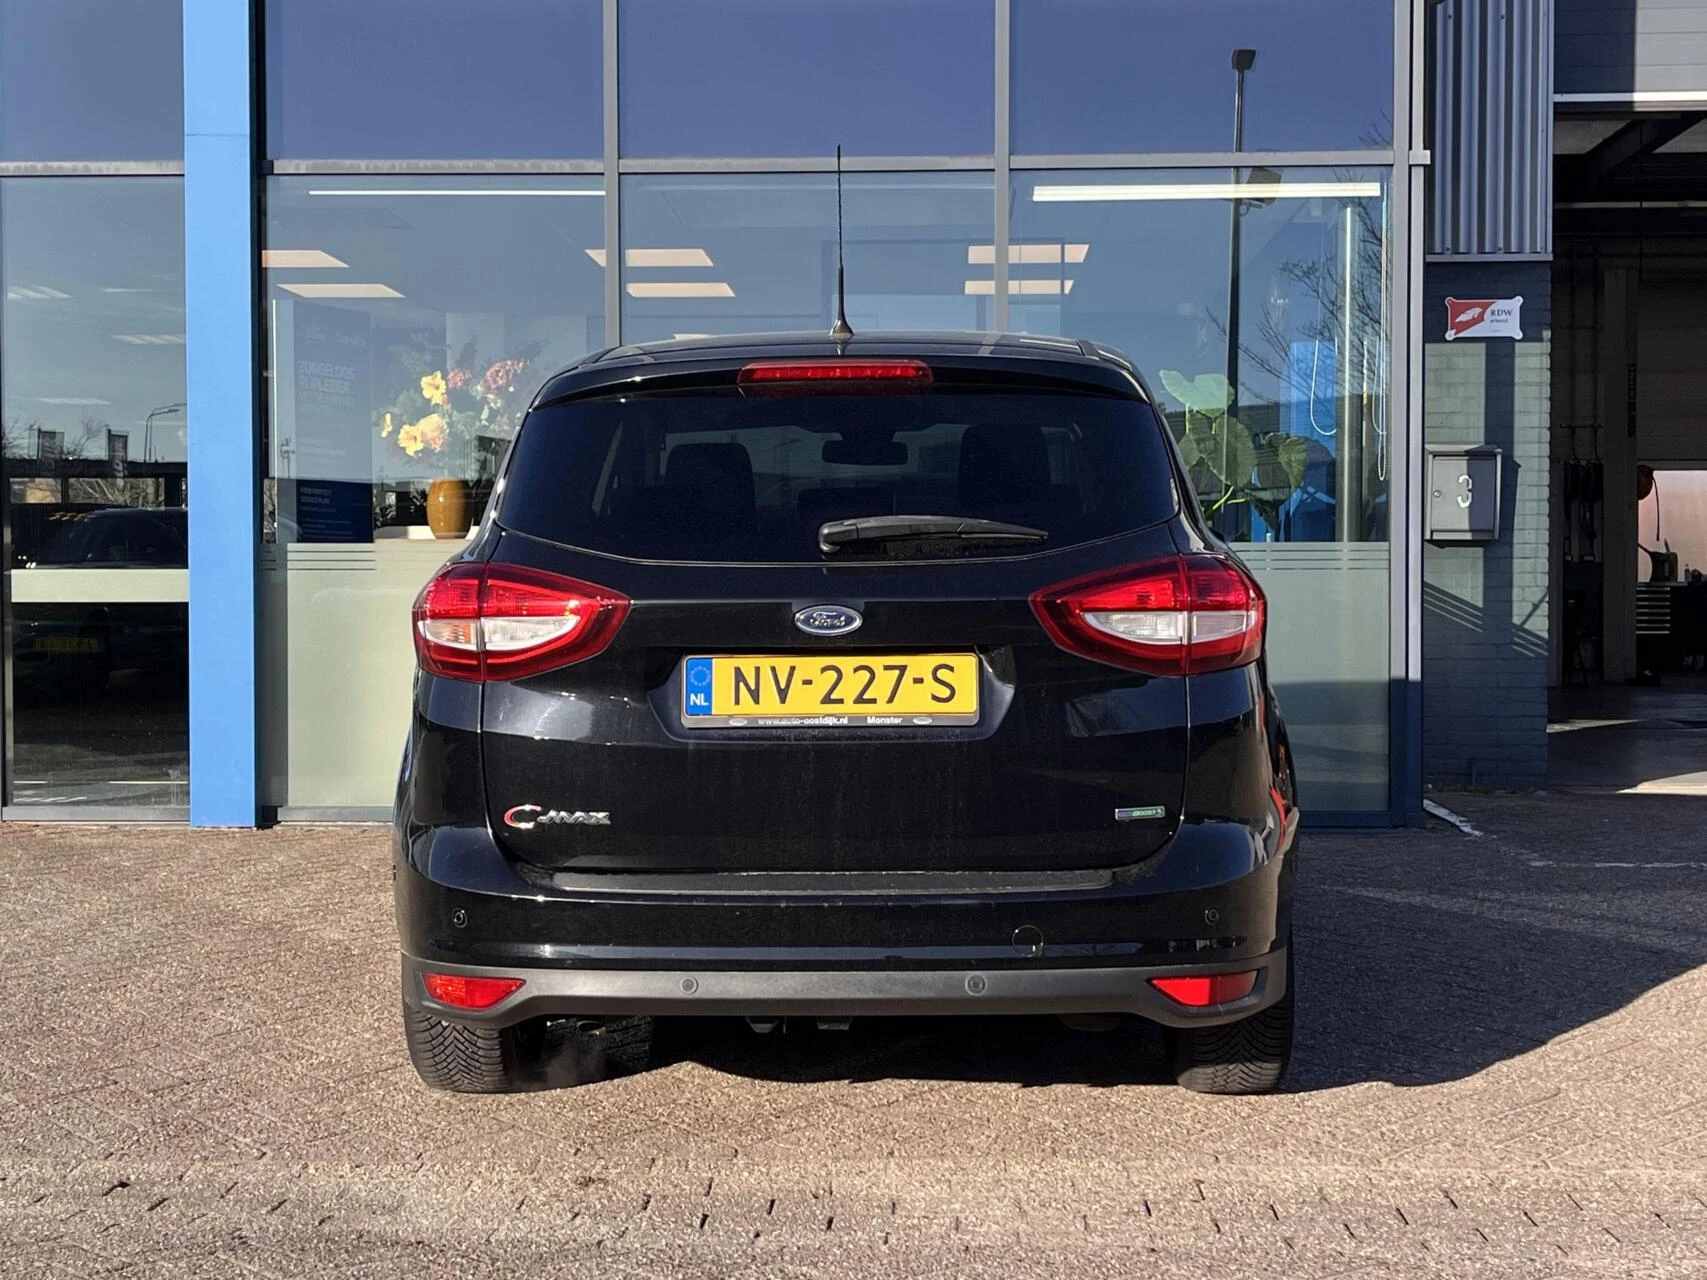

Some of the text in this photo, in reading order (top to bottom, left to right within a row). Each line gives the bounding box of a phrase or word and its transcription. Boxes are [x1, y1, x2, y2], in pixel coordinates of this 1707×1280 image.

[1490, 309, 1513, 317] RDW
[1457, 474, 1473, 508] 3
[809, 610, 846, 628] Ford
[733, 663, 957, 706] NV-227-S
[690, 693, 709, 706] NL
[866, 716, 903, 725] Monster
